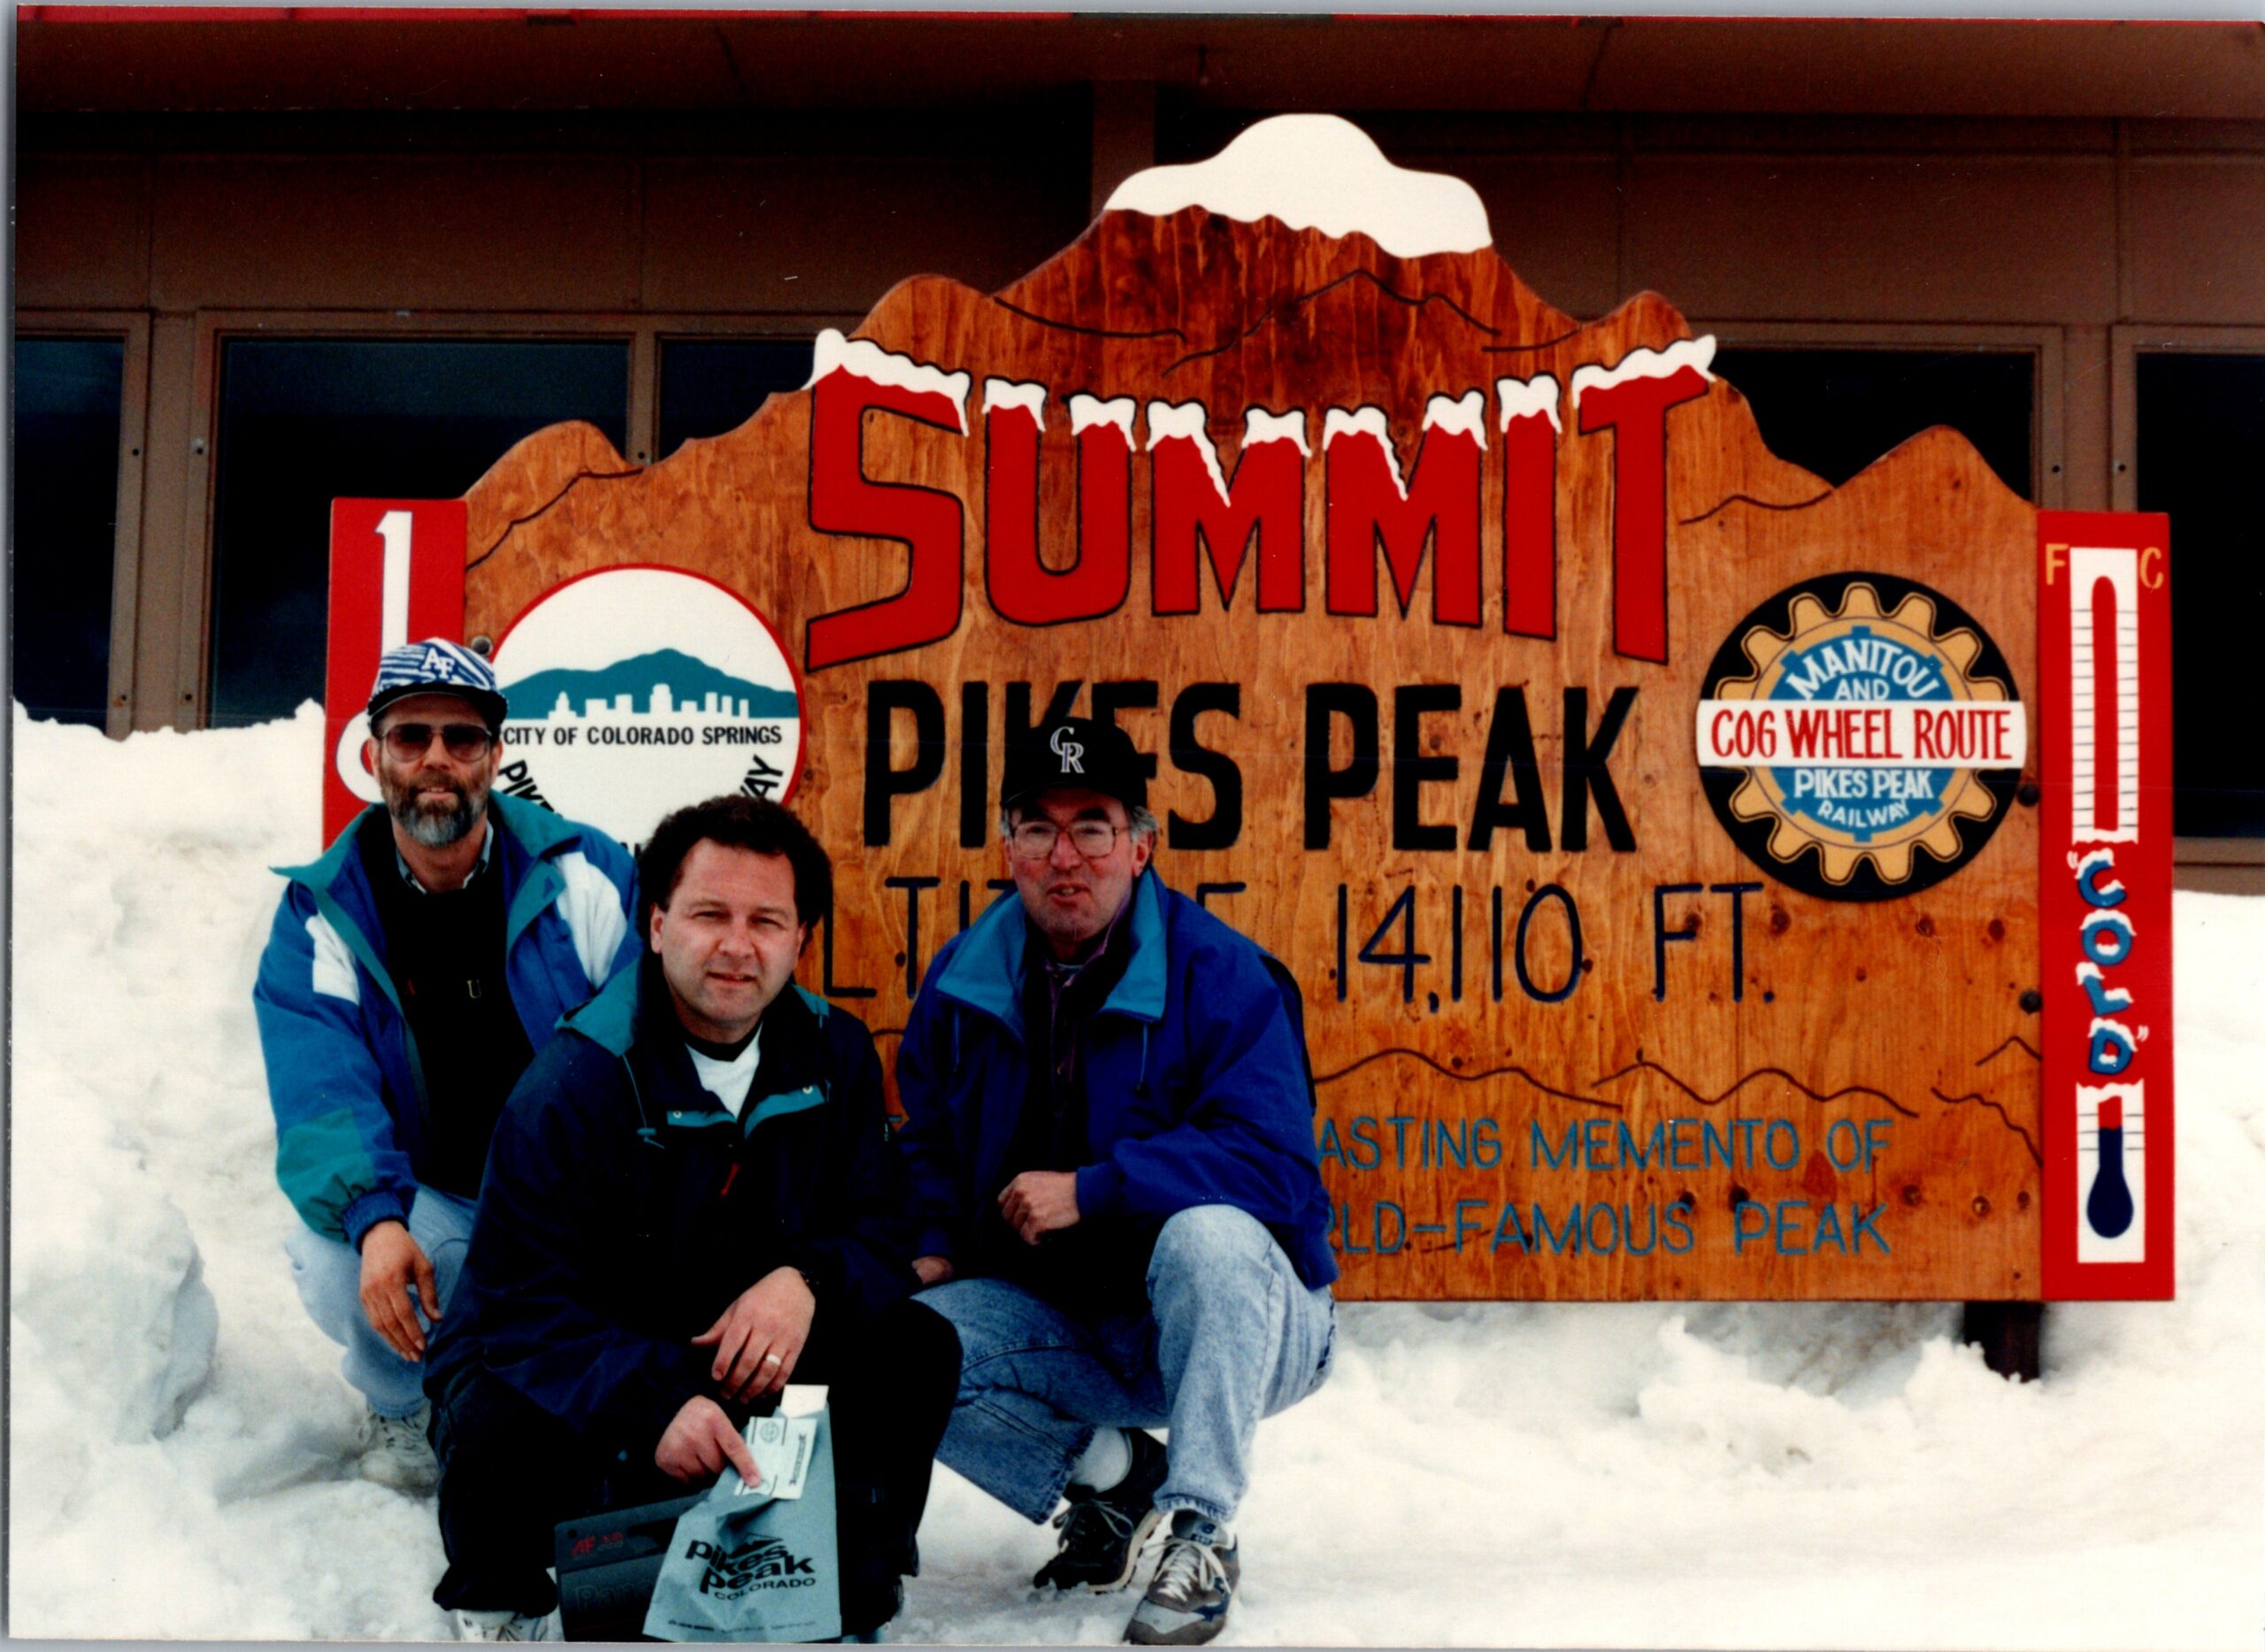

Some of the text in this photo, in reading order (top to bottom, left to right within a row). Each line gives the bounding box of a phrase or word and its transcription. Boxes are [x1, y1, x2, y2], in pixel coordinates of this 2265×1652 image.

[804, 331, 1716, 670] SUMMIT
[2045, 543, 2069, 586] F
[2138, 546, 2163, 592] C
[421, 648, 456, 679] AF
[1785, 639, 1939, 700] MANITOU
[1833, 678, 1890, 700] AND
[503, 726, 782, 745] CITY OF COLORADO SPRINGS
[1711, 709, 2012, 759] COG WHEEL ROUTE
[1303, 681, 1639, 852] PEAK
[1793, 769, 1935, 799] PIKES PEAK
[1816, 797, 1910, 827] RAILWAY
[1336, 882, 1583, 1014] 14,110
[1653, 881, 1775, 1003] FT.
[1317, 1117, 1893, 1173] ASTING MEMENTO OF
[1734, 1201, 1892, 1256] PEAK
[714, 1578, 817, 1601] COLORADO
